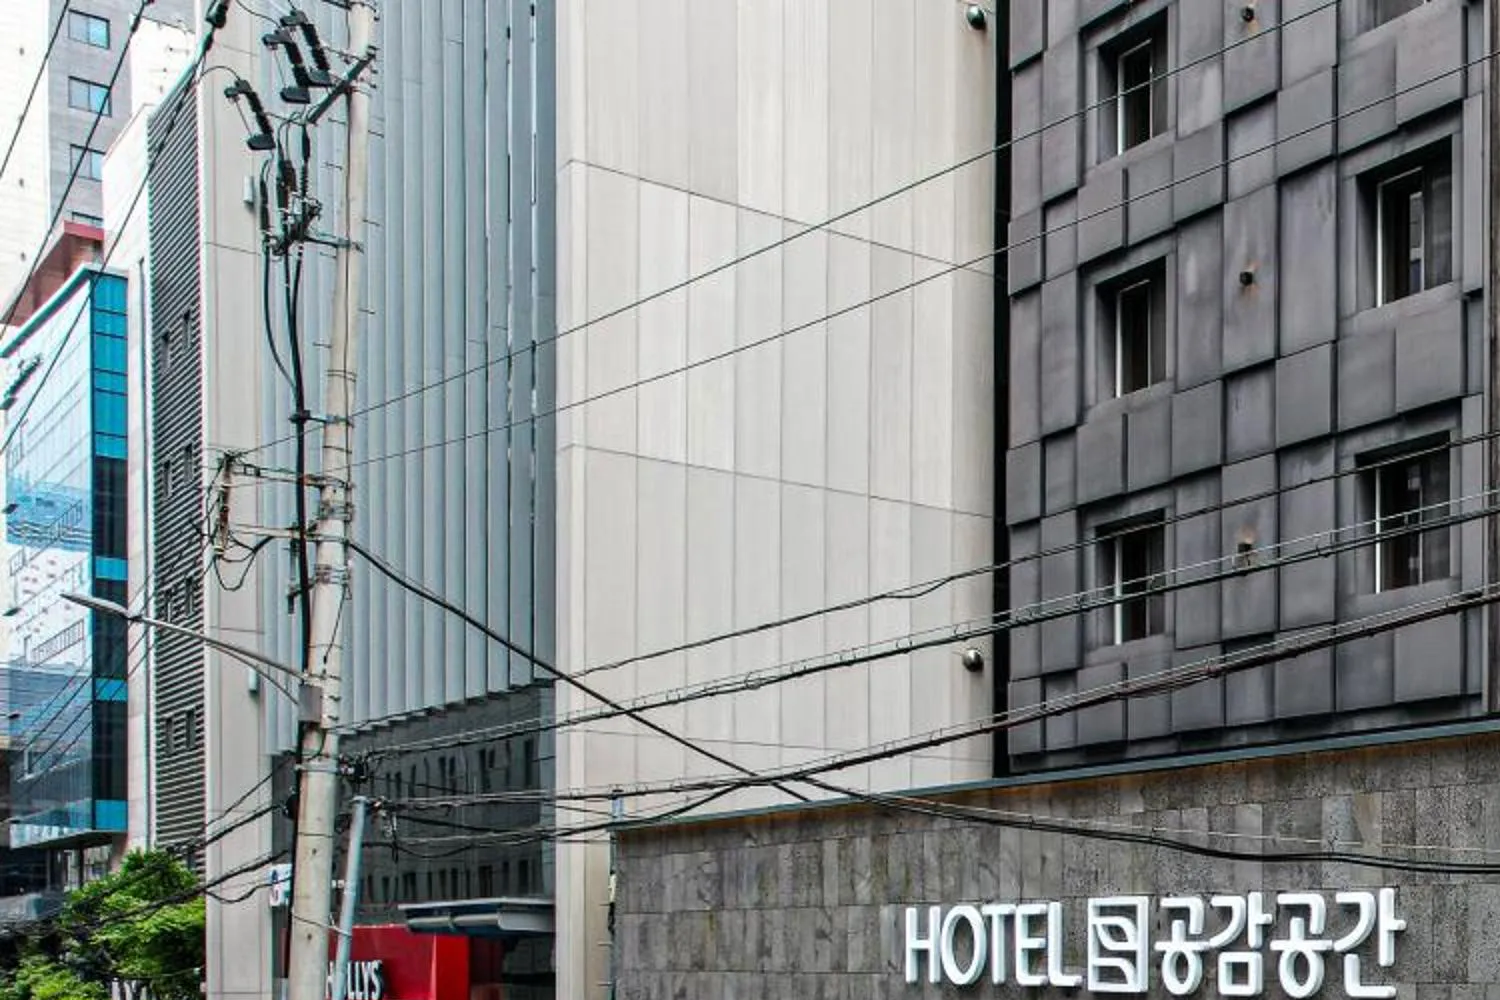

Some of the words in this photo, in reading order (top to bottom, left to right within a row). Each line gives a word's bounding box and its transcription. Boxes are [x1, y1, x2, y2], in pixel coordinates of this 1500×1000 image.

[325, 960, 382, 1000] HLLYS
[905, 901, 1083, 987] HOTEL
[1154, 888, 1407, 999] 공감공간
